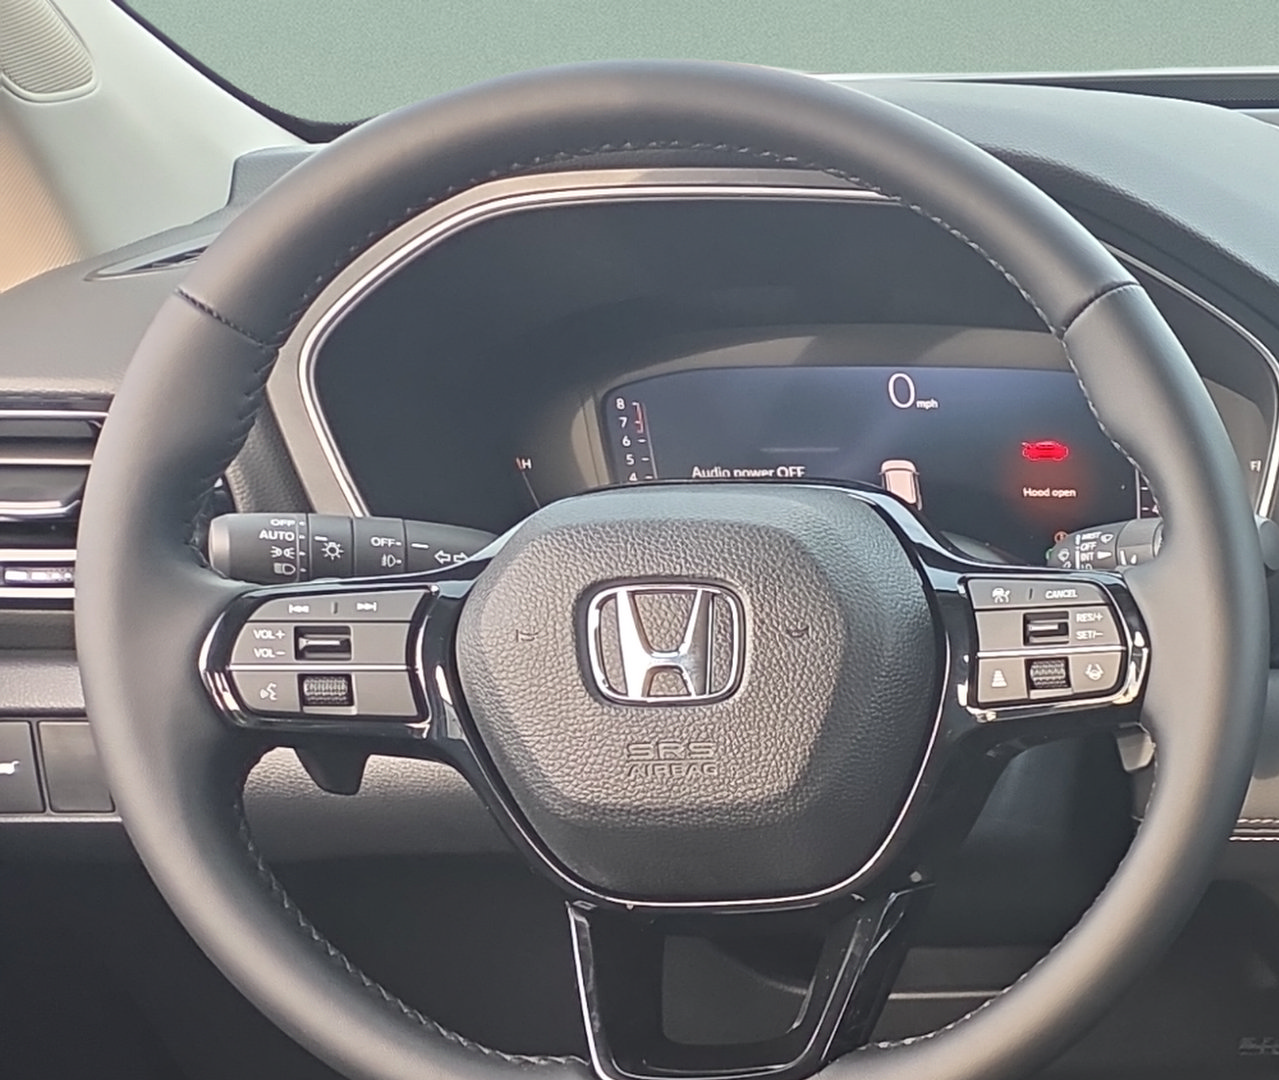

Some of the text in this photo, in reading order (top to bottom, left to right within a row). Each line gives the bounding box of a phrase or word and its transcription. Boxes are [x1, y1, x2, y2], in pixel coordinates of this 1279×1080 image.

[886, 372, 940, 411] 0 mph
[615, 398, 626, 410] 8
[619, 417, 628, 429] 7
[622, 435, 631, 447] 6
[625, 453, 635, 465] 5
[628, 471, 638, 482] 4
[691, 465, 731, 478] Audio
[776, 465, 806, 478] OFF
[1022, 486, 1077, 500] Hood open
[270, 518, 296, 527] OFF
[258, 529, 295, 542] AUTO
[370, 536, 395, 548] OFF
[1080, 541, 1098, 551] OFF
[1045, 588, 1079, 600] CANCEL
[626, 741, 718, 760] SRS
[626, 762, 719, 778] AIRBAG
